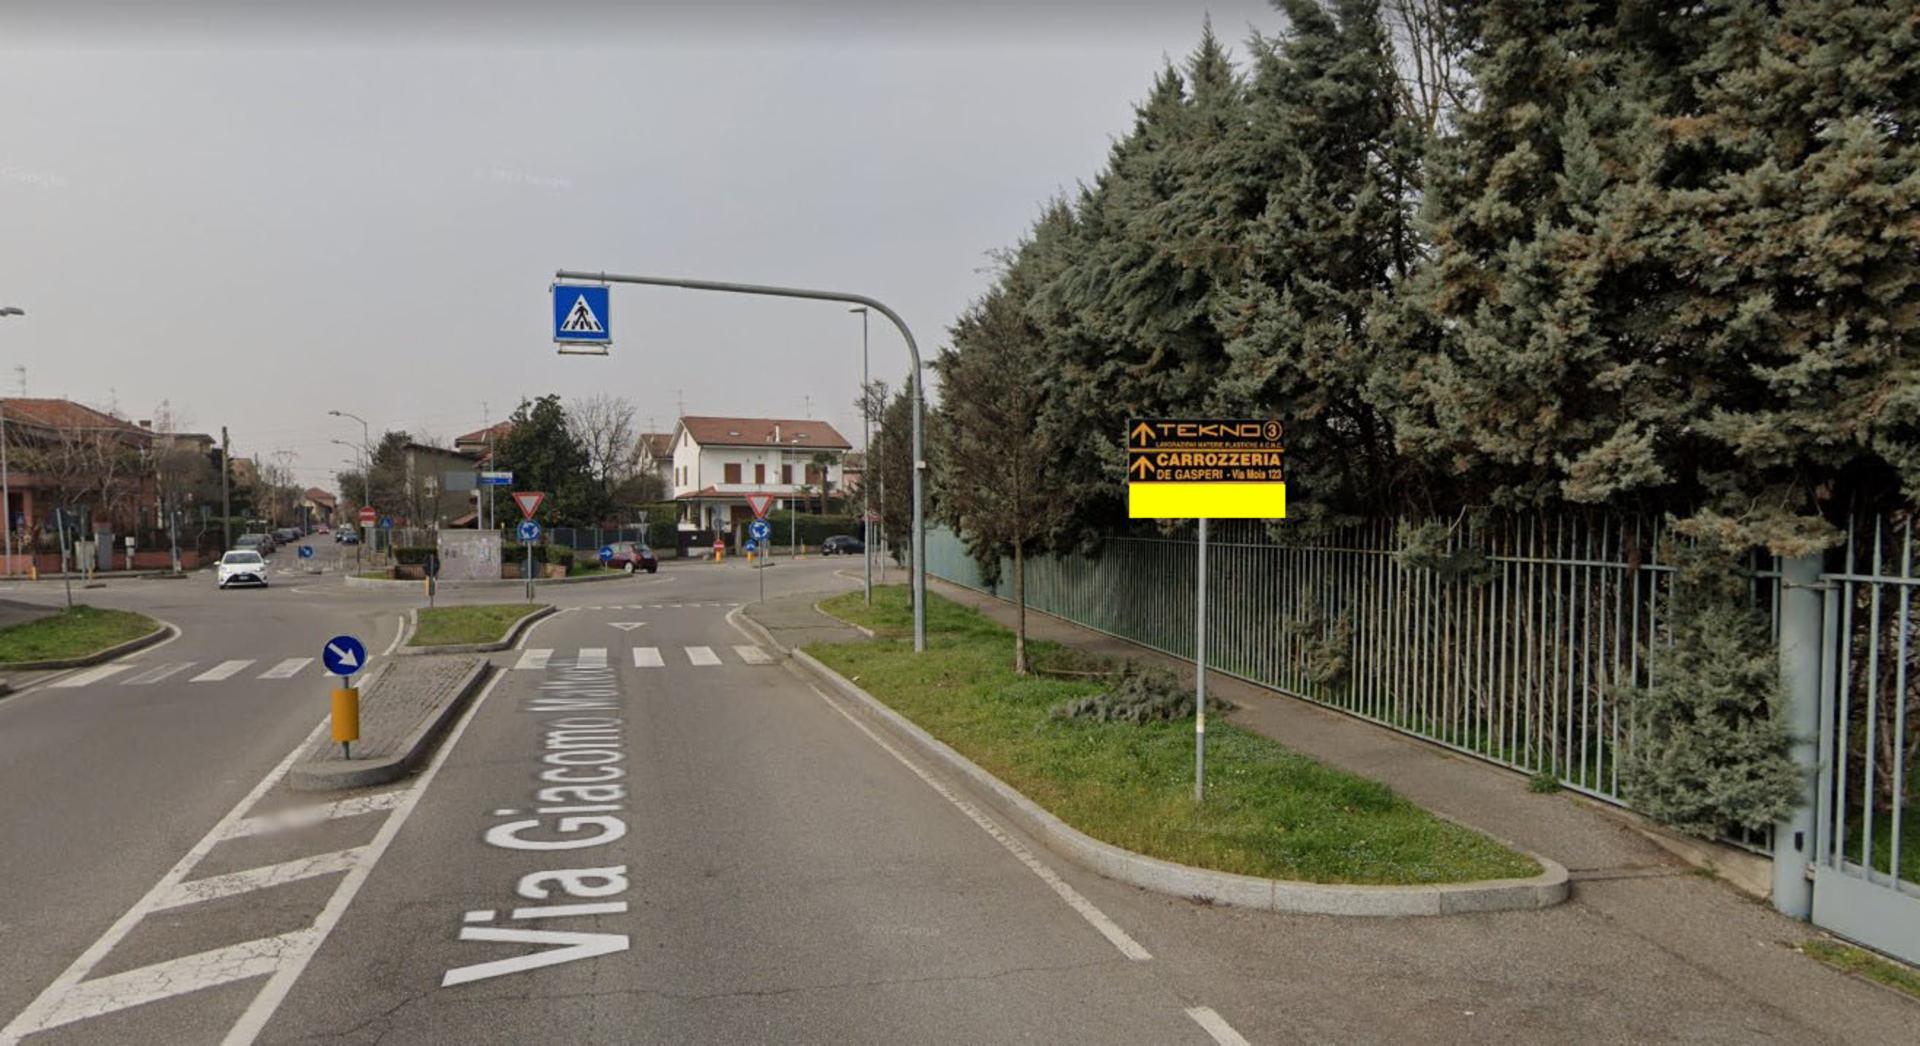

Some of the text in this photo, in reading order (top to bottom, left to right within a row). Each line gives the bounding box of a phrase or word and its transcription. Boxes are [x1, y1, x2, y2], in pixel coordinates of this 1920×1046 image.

[1156, 423, 1260, 437] TEKNO
[1156, 453, 1281, 466] CARROZZERIA
[1156, 469, 1171, 480] DE
[1174, 469, 1223, 480] GASPERI
[1232, 468, 1245, 479] Via
[1268, 468, 1282, 480] 123
